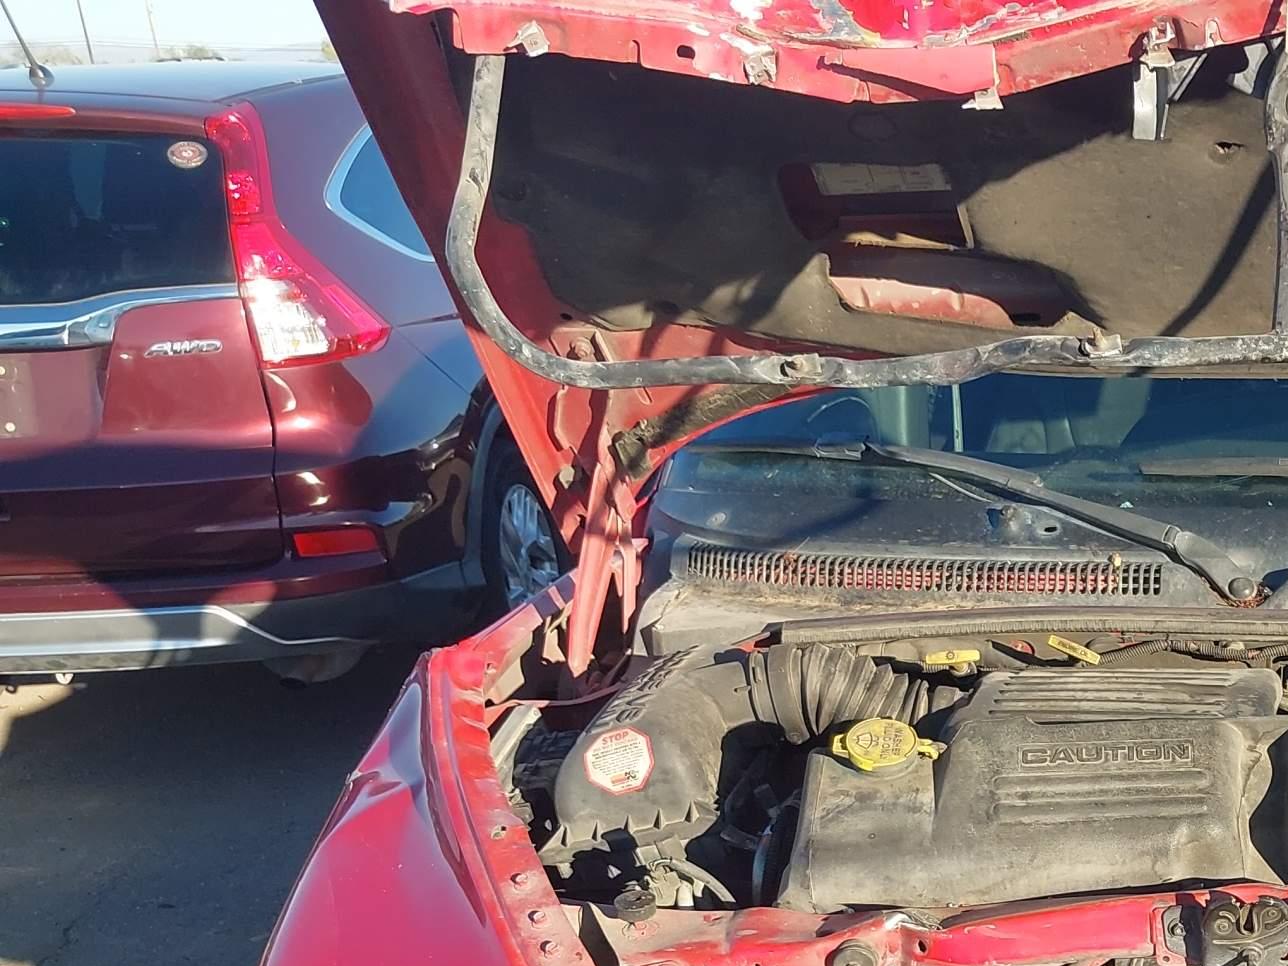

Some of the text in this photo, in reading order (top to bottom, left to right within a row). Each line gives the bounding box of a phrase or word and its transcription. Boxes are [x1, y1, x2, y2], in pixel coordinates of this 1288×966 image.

[143, 338, 223, 358] AWD
[601, 730, 629, 745] STOP
[1021, 743, 1191, 766] CAUTION
